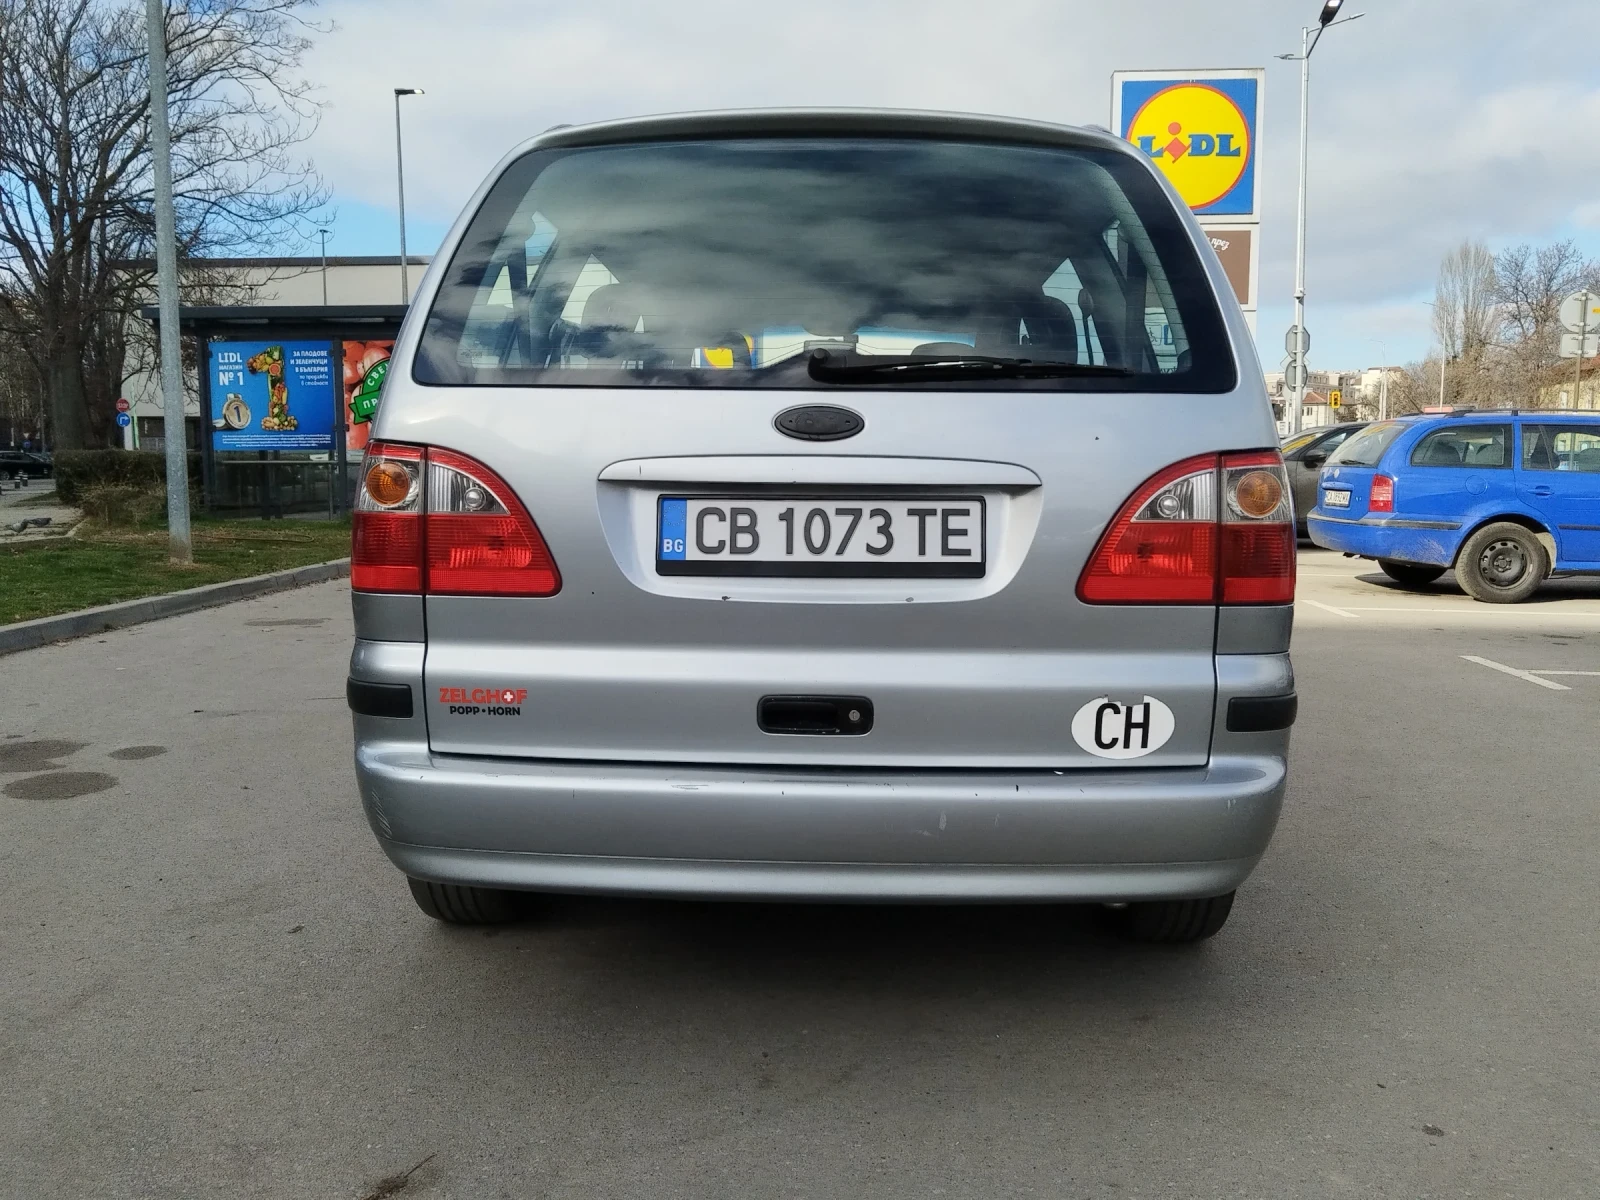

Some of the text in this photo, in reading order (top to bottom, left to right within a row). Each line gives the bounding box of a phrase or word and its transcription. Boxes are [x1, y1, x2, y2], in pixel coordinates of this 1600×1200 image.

[218, 352, 243, 363] LIDL
[301, 350, 328, 358] ПЛОДОВЕ
[237, 371, 244, 386] 1
[367, 362, 389, 387] СВЕ
[695, 506, 972, 557] CB 1073 TE
[663, 538, 684, 553] BG
[439, 686, 528, 705] ZELGHOF
[449, 705, 521, 716] POPP HORN
[1094, 702, 1151, 750] CH
